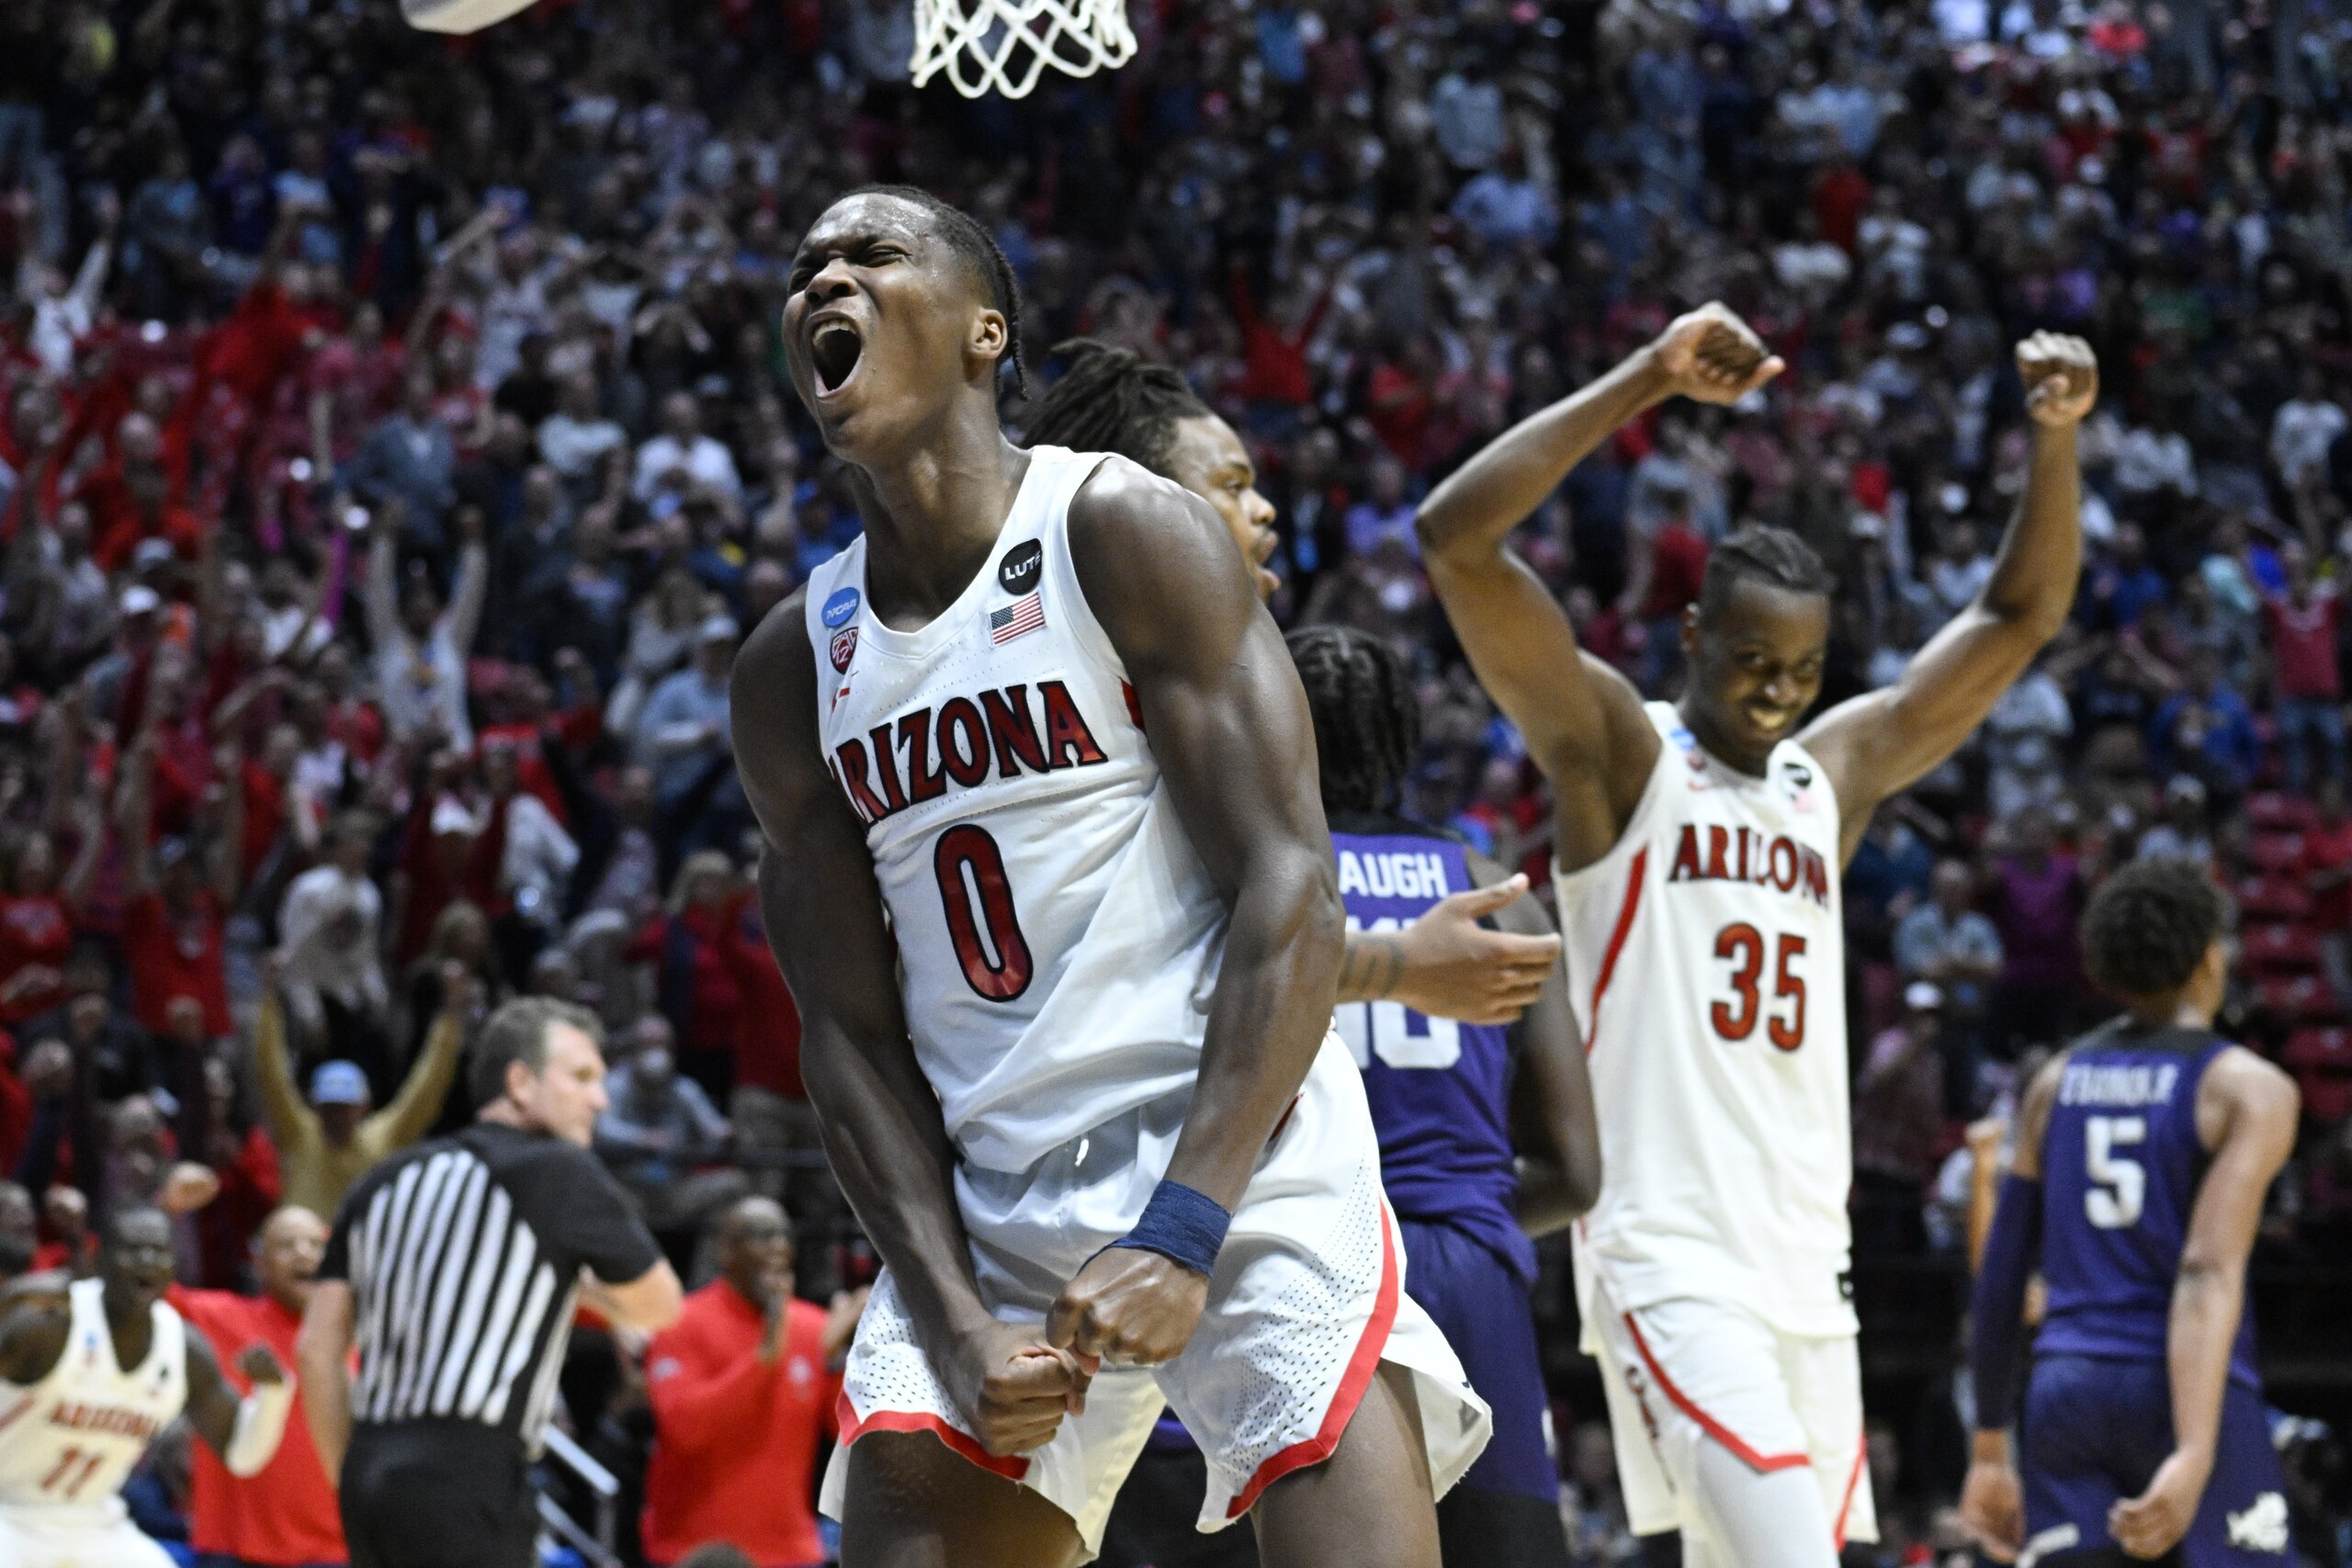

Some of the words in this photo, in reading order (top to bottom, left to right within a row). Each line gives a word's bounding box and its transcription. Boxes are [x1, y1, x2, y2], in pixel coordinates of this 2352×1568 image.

[1004, 550, 1041, 581] LUTE
[827, 599, 856, 619] NCAA
[836, 646, 849, 665] 12
[829, 681, 1107, 825] RIZONA
[934, 824, 1035, 1002] 0
[1710, 922, 1807, 1052] 35
[2085, 1116, 2145, 1228] 5
[40, 1445, 103, 1500] 11
